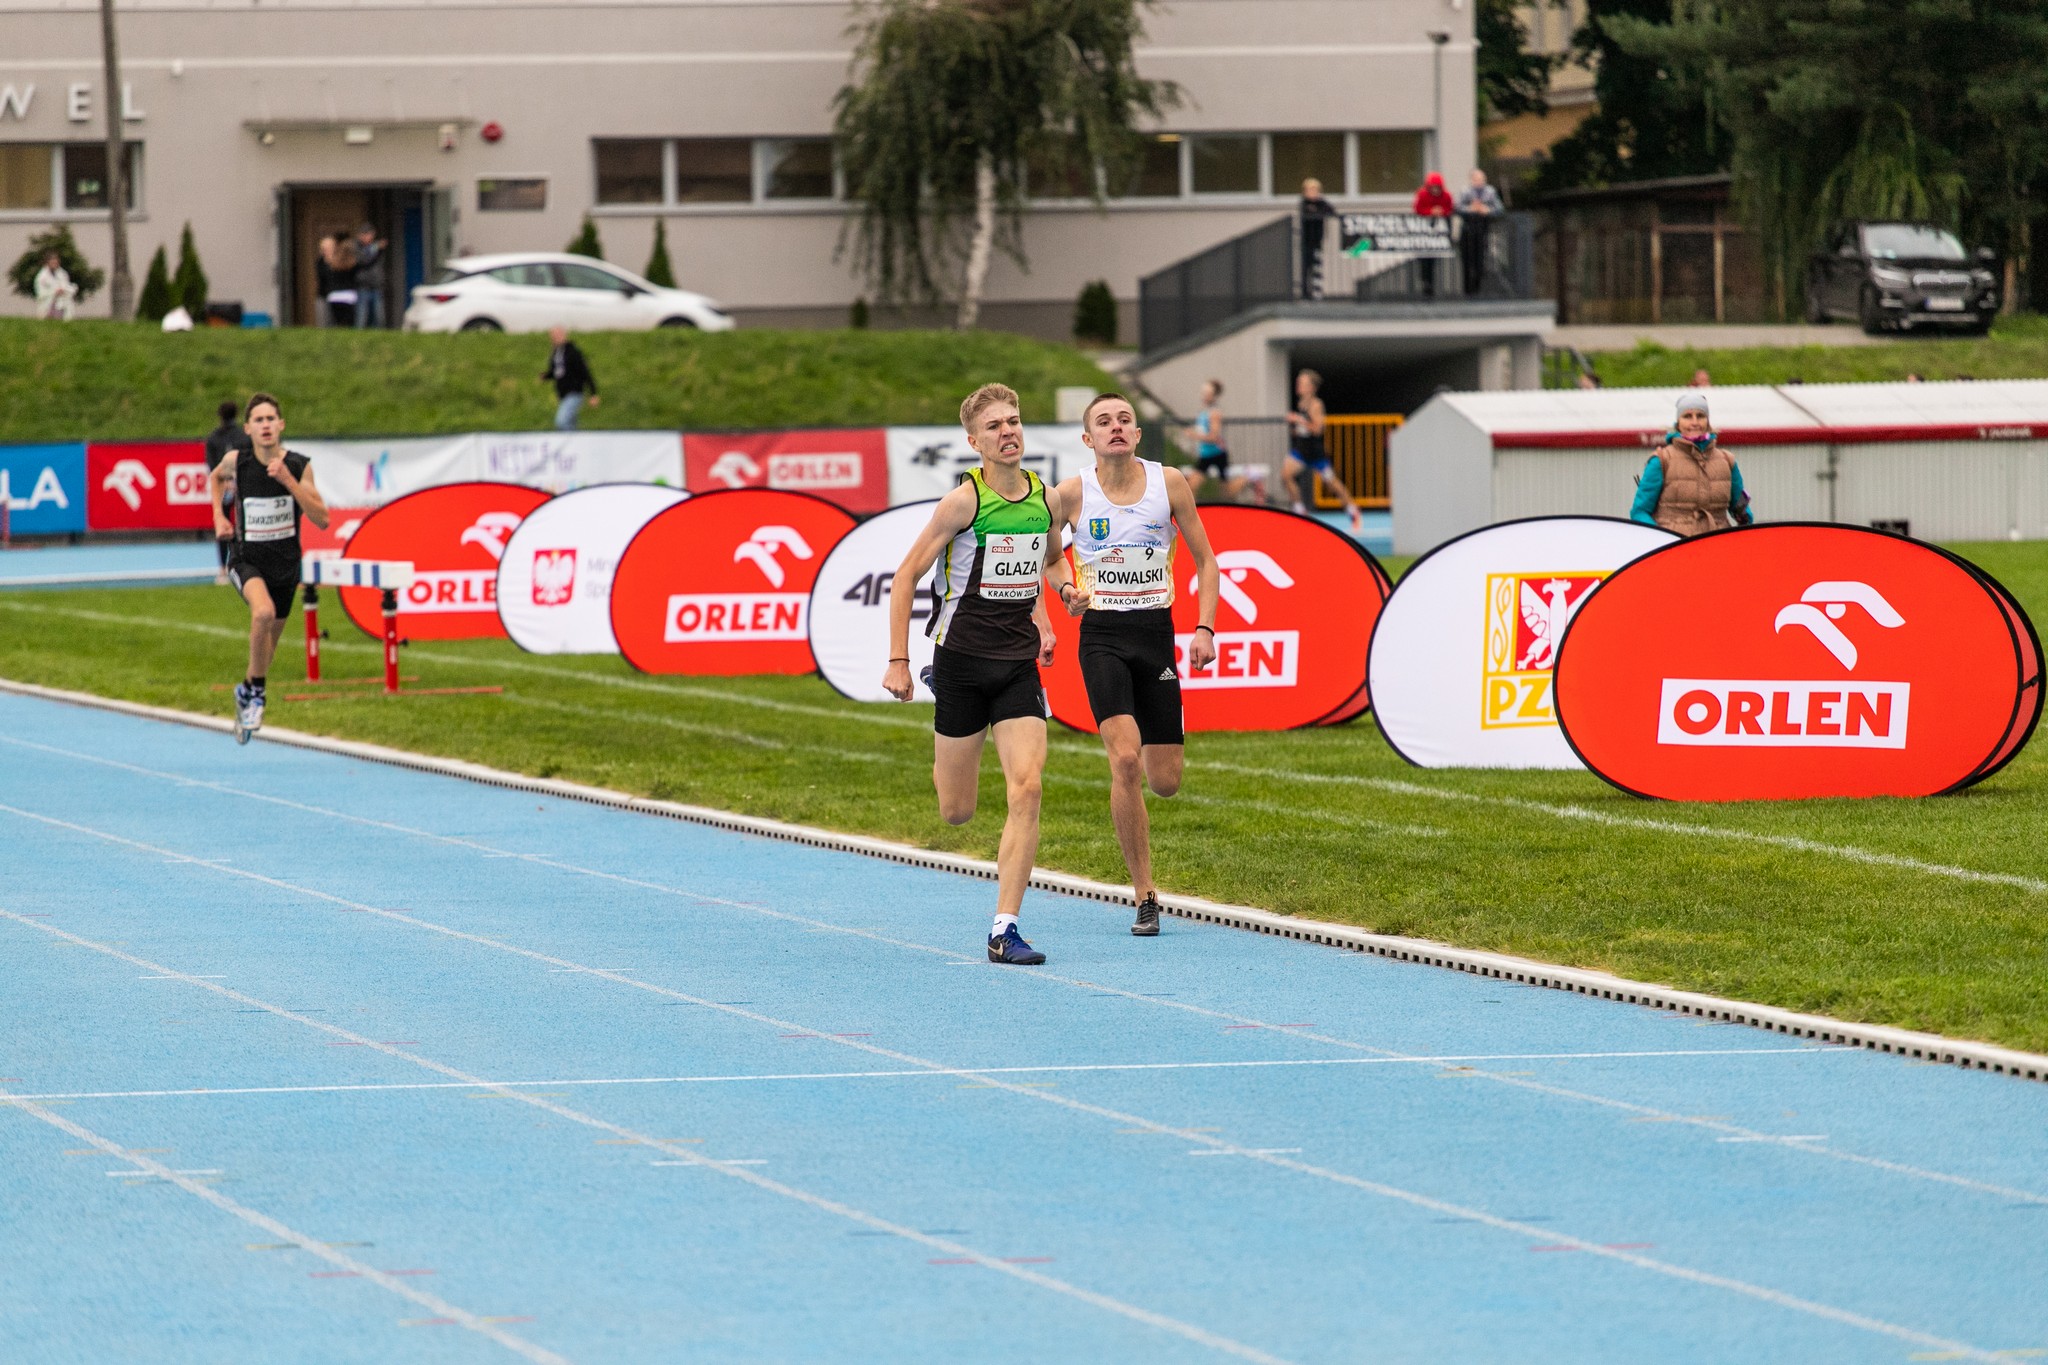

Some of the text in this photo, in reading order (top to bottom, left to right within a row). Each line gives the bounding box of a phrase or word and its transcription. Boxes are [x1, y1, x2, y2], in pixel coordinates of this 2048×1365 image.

[770, 460, 853, 481] ORLEN
[1031, 536, 1040, 551] 6
[1145, 547, 1154, 561] 9
[995, 560, 1038, 576] GLAZA
[1098, 567, 1163, 585] KOWALSKI
[987, 589, 1023, 598] KRAKÓW
[1102, 595, 1161, 606] KRAKÓW 2022
[676, 602, 800, 633] ORLEN
[1489, 677, 1555, 720] PZ
[1673, 689, 1892, 737] ORLEN
